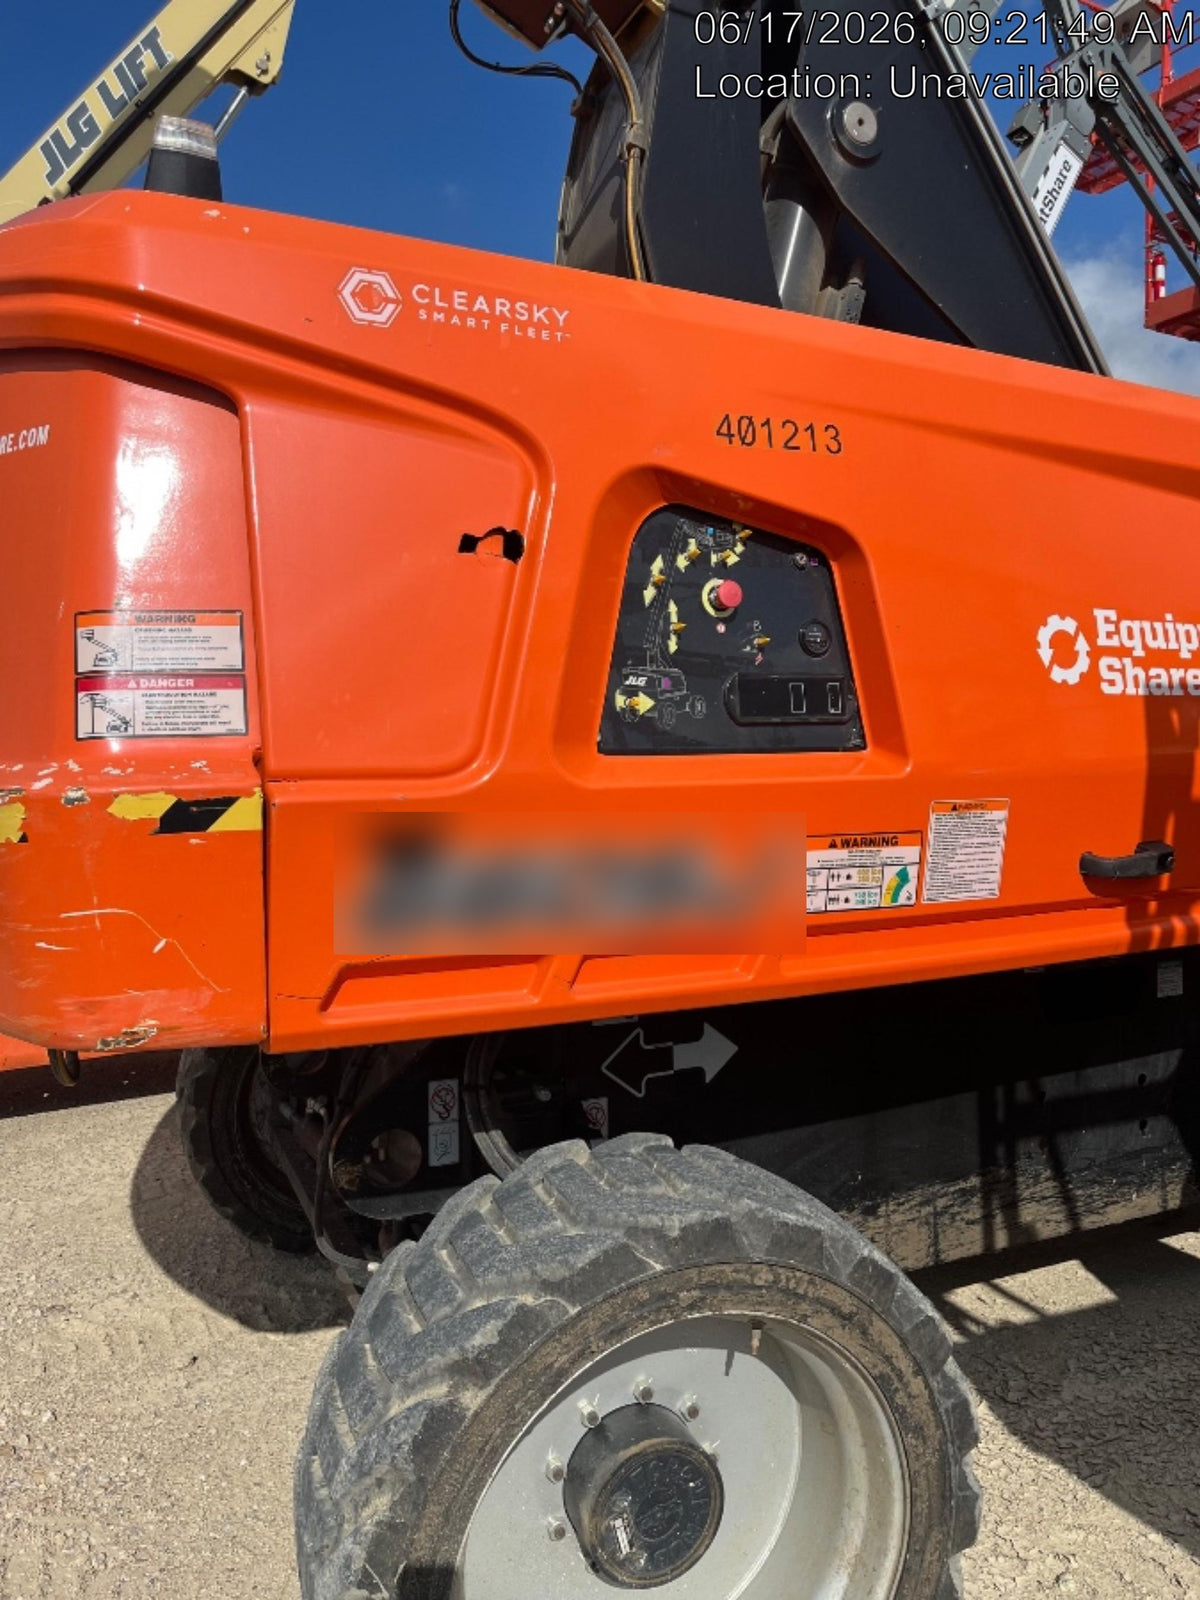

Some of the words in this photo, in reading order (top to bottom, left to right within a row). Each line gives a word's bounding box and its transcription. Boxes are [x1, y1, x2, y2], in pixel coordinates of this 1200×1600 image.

[38, 100, 104, 188] JLG
[95, 25, 170, 120] LIFT
[411, 283, 570, 327] CLEARSKY
[418, 308, 491, 330] SMART
[715, 413, 842, 455] 401213
[134, 614, 196, 624] WARNING
[1093, 608, 1200, 659] Equip
[139, 678, 195, 688] DANGER
[1098, 655, 1200, 696] Share
[840, 835, 899, 849] WARNING
